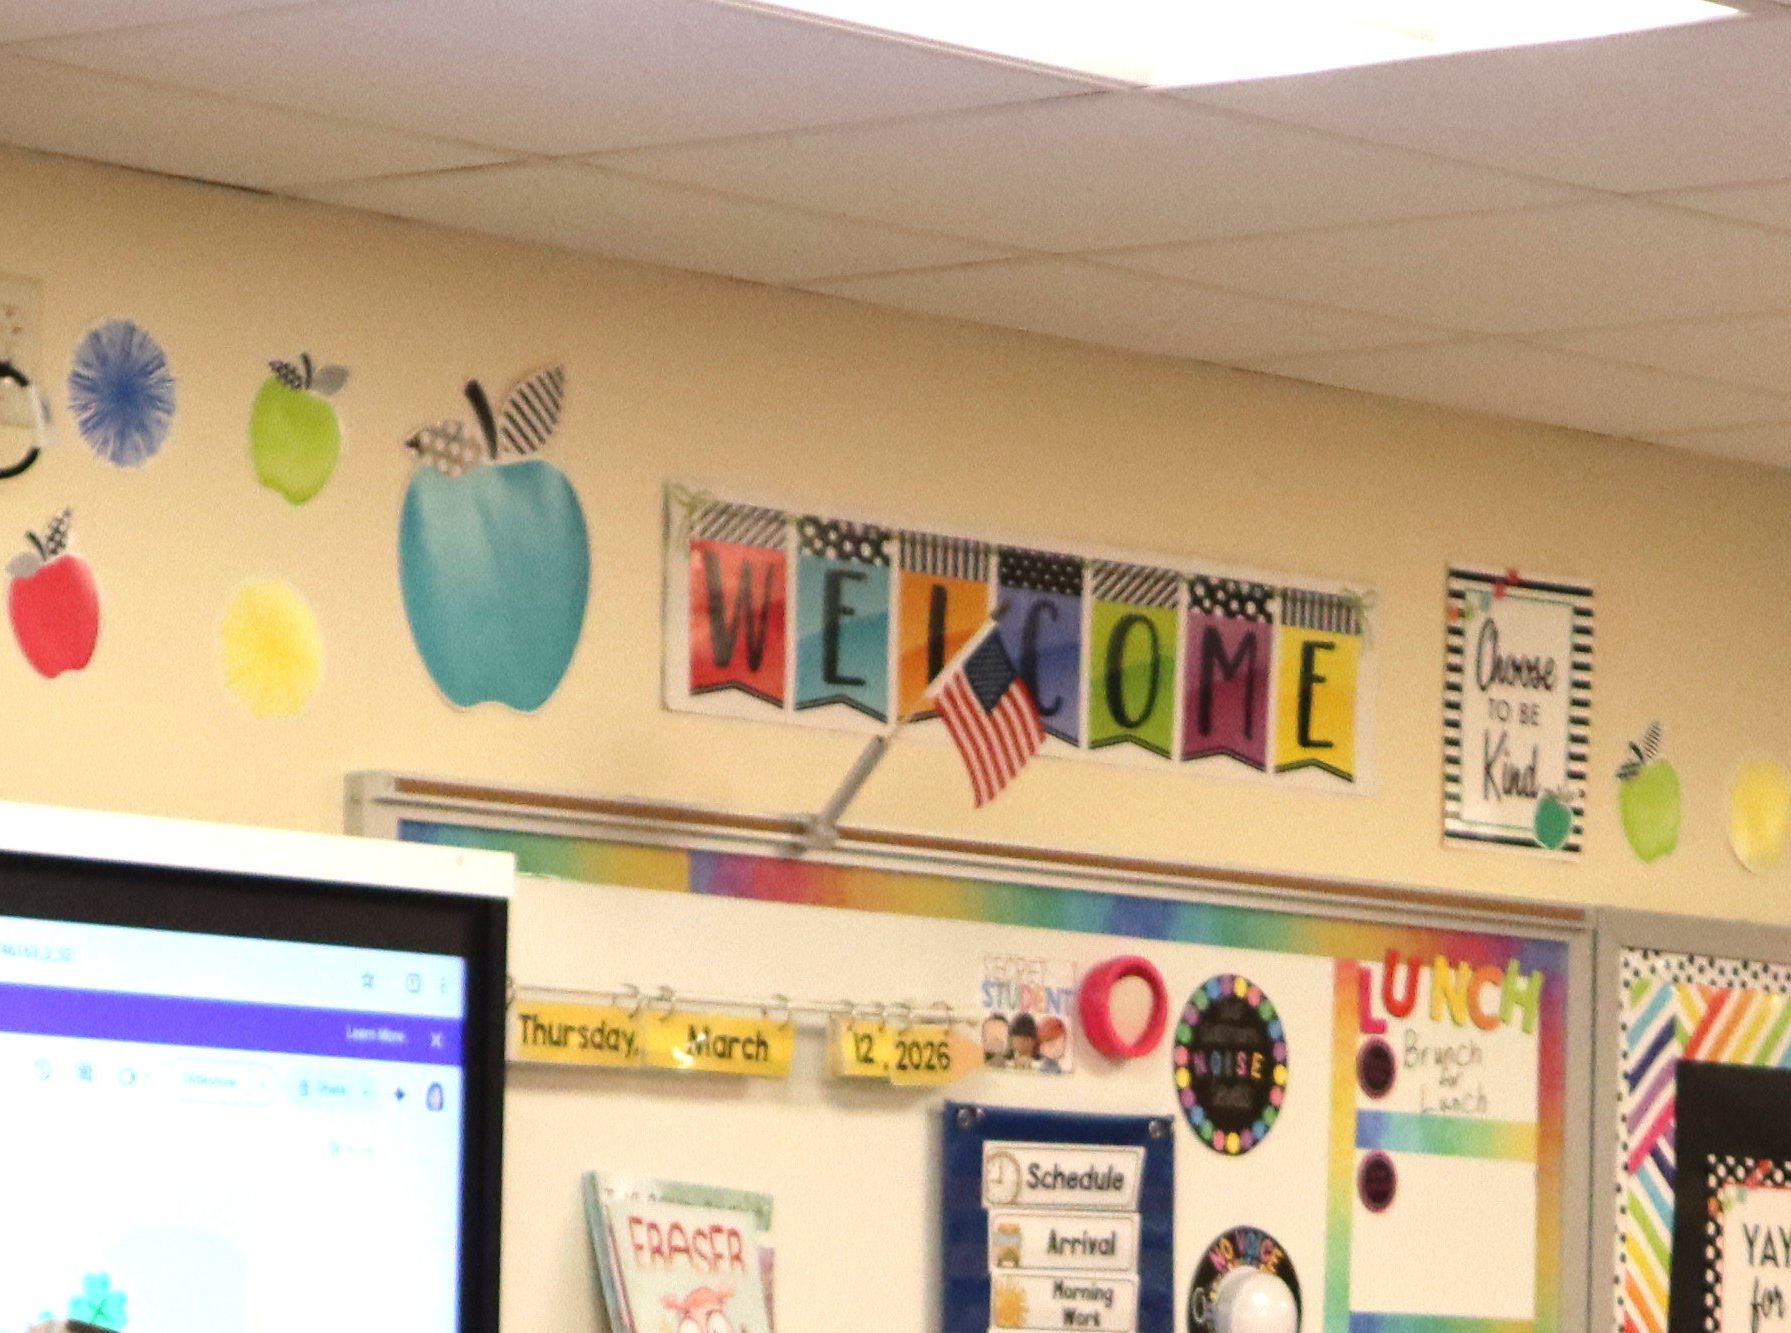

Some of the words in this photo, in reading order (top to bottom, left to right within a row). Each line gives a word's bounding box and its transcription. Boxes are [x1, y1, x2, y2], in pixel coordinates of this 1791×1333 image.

[1475, 617, 1557, 693] Choose
[1487, 697, 1512, 723] TO
[1516, 701, 1542, 726] BE
[1481, 731, 1542, 803] Kind
[1359, 946, 1546, 1036] LUNCH
[686, 1024, 772, 1062] March
[895, 1038, 952, 1072] 2026
[1192, 1049, 1266, 1081] NOISE
[1025, 1161, 1125, 1194] Schedule
[1046, 1228, 1119, 1259] Arrival
[1051, 1279, 1116, 1308] Morning
[1061, 1305, 1103, 1328] Work
